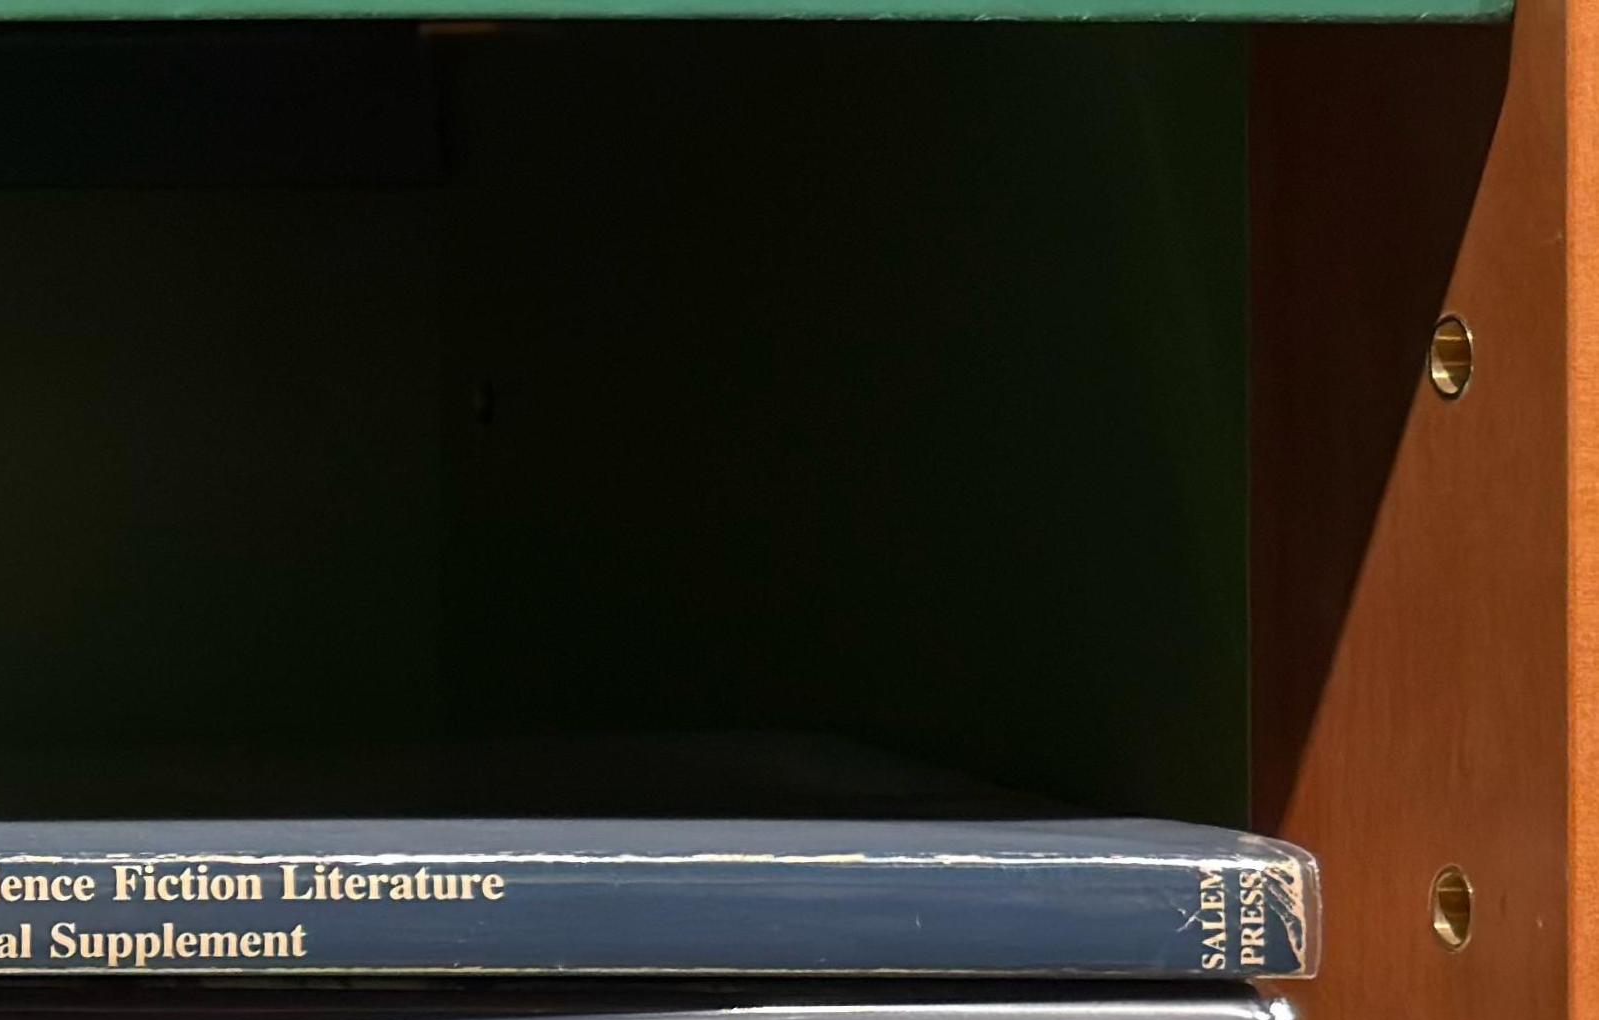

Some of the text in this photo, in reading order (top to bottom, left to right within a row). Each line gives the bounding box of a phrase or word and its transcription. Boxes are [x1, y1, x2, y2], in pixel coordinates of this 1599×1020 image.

[114, 863, 264, 903] Fiction
[281, 864, 505, 901] Literature
[1240, 871, 1265, 965] PRESS
[51, 921, 307, 967] Supplement
[1200, 868, 1226, 970] SALEM
